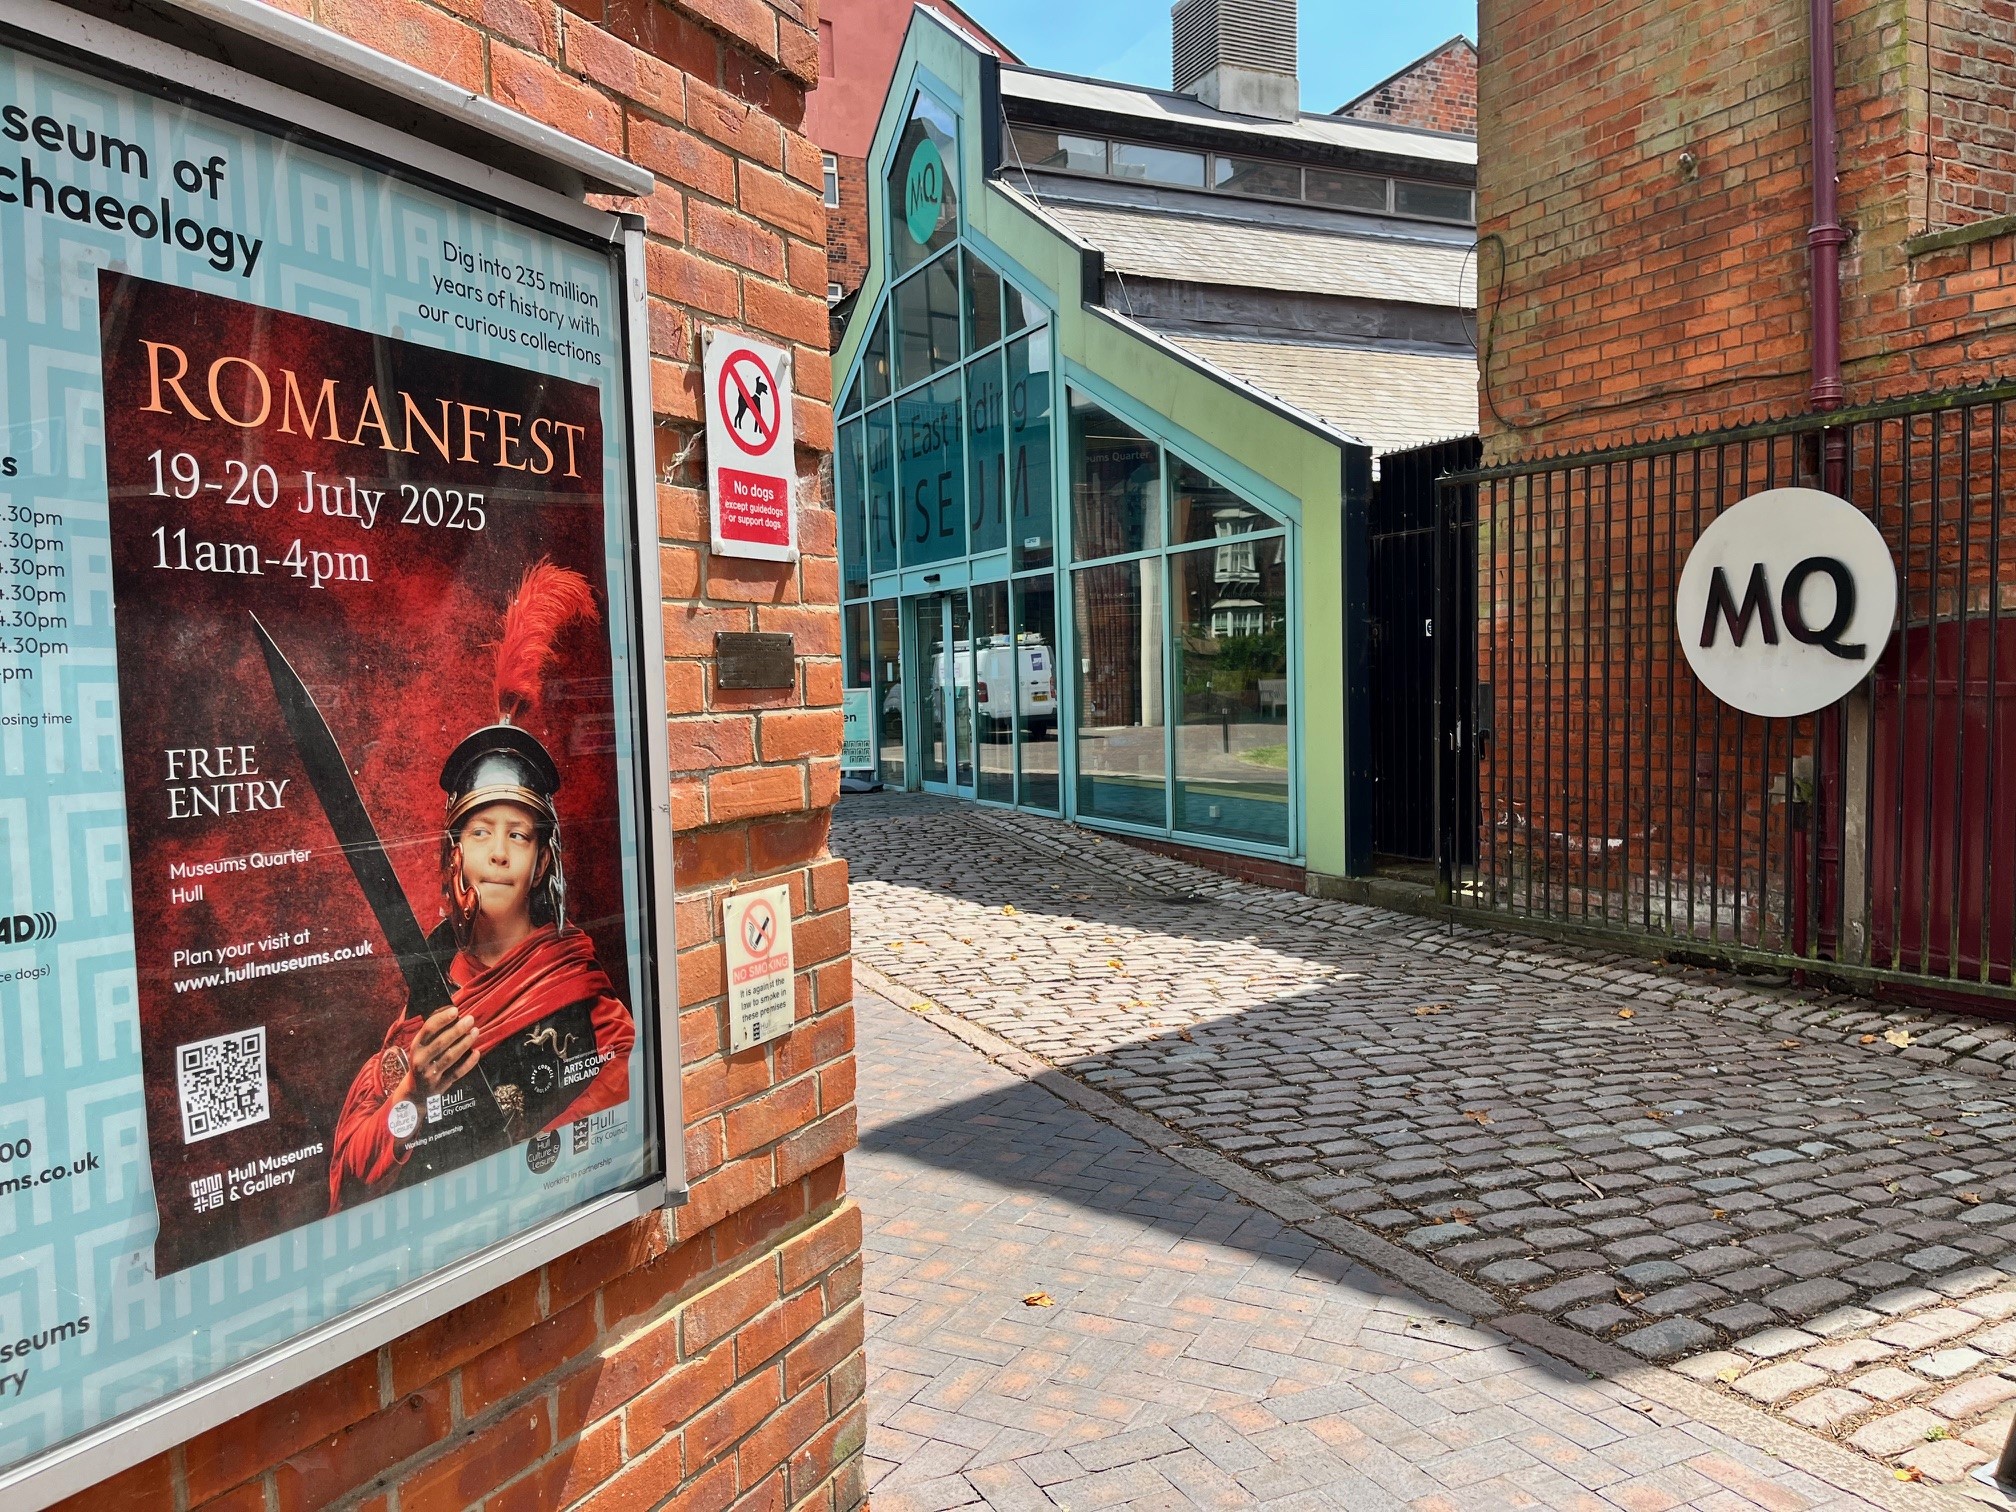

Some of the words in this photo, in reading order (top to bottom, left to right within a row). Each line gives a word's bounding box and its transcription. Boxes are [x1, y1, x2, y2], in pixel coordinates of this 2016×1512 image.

[173, 156, 227, 200] of
[910, 162, 937, 216] MQ
[443, 241, 473, 273] Dig
[479, 253, 511, 280] into
[516, 265, 545, 291] 235
[550, 281, 598, 308] million
[433, 275, 482, 302] years
[488, 290, 506, 308] of
[510, 292, 564, 330] history
[569, 315, 599, 337] with
[419, 304, 449, 323] our
[455, 313, 516, 342] curious
[521, 332, 601, 365] collections
[138, 338, 585, 479] ROMANFEST
[911, 405, 949, 459] East
[1112, 451, 1151, 462] Quarter
[147, 449, 279, 509] 19-20
[298, 470, 386, 530] July
[400, 485, 487, 531] 2025
[733, 480, 748, 496] No
[750, 484, 774, 502] dogs
[725, 500, 748, 512] except
[750, 503, 784, 518] guidedogs
[728, 514, 736, 522] or
[738, 515, 764, 527] support
[765, 518, 781, 530] dogs
[151, 526, 373, 590] 11am-4pm
[1699, 556, 1867, 660] MQ
[42, 712, 72, 724] time
[165, 745, 260, 781] FREE
[166, 779, 290, 819] ENTRY
[170, 856, 247, 880] Museums
[250, 849, 312, 870] Quarter
[171, 885, 203, 904] Hull
[173, 948, 213, 968] Plan
[216, 942, 254, 964] your
[258, 933, 291, 954] visit
[293, 928, 311, 946] at
[15, 964, 51, 979] dogs)
[174, 940, 374, 993] www.hullmuseums.co.uk
[733, 968, 747, 983] NO
[749, 955, 788, 978] SMOKING
[741, 1002, 751, 1010] law
[753, 998, 759, 1006] to
[760, 991, 780, 1004] smoke
[781, 989, 786, 998] in
[746, 988, 751, 996] is
[753, 981, 774, 995] against
[775, 977, 785, 986] the
[742, 1011, 759, 1023] these
[760, 1001, 786, 1018] premises
[564, 1061, 584, 1075] ARTS
[584, 1051, 616, 1068] COUNCIL
[564, 1067, 600, 1086] ENGLAND
[442, 1089, 463, 1106] Hull
[443, 1108, 454, 1116] City
[455, 1100, 476, 1112] Council
[590, 1110, 614, 1132] Hull
[404, 1138, 427, 1150] Working
[434, 1125, 464, 1141] partnership
[591, 1135, 603, 1145] City
[605, 1124, 628, 1140] Council
[228, 1161, 256, 1185] Hull
[259, 1142, 324, 1174] Museums
[528, 1148, 551, 1163] Culture
[532, 1156, 556, 1170] Leisure
[229, 1186, 241, 1201] &
[242, 1169, 295, 1196] Gallery
[543, 1175, 570, 1190] Working
[578, 1157, 613, 1177] partnership
